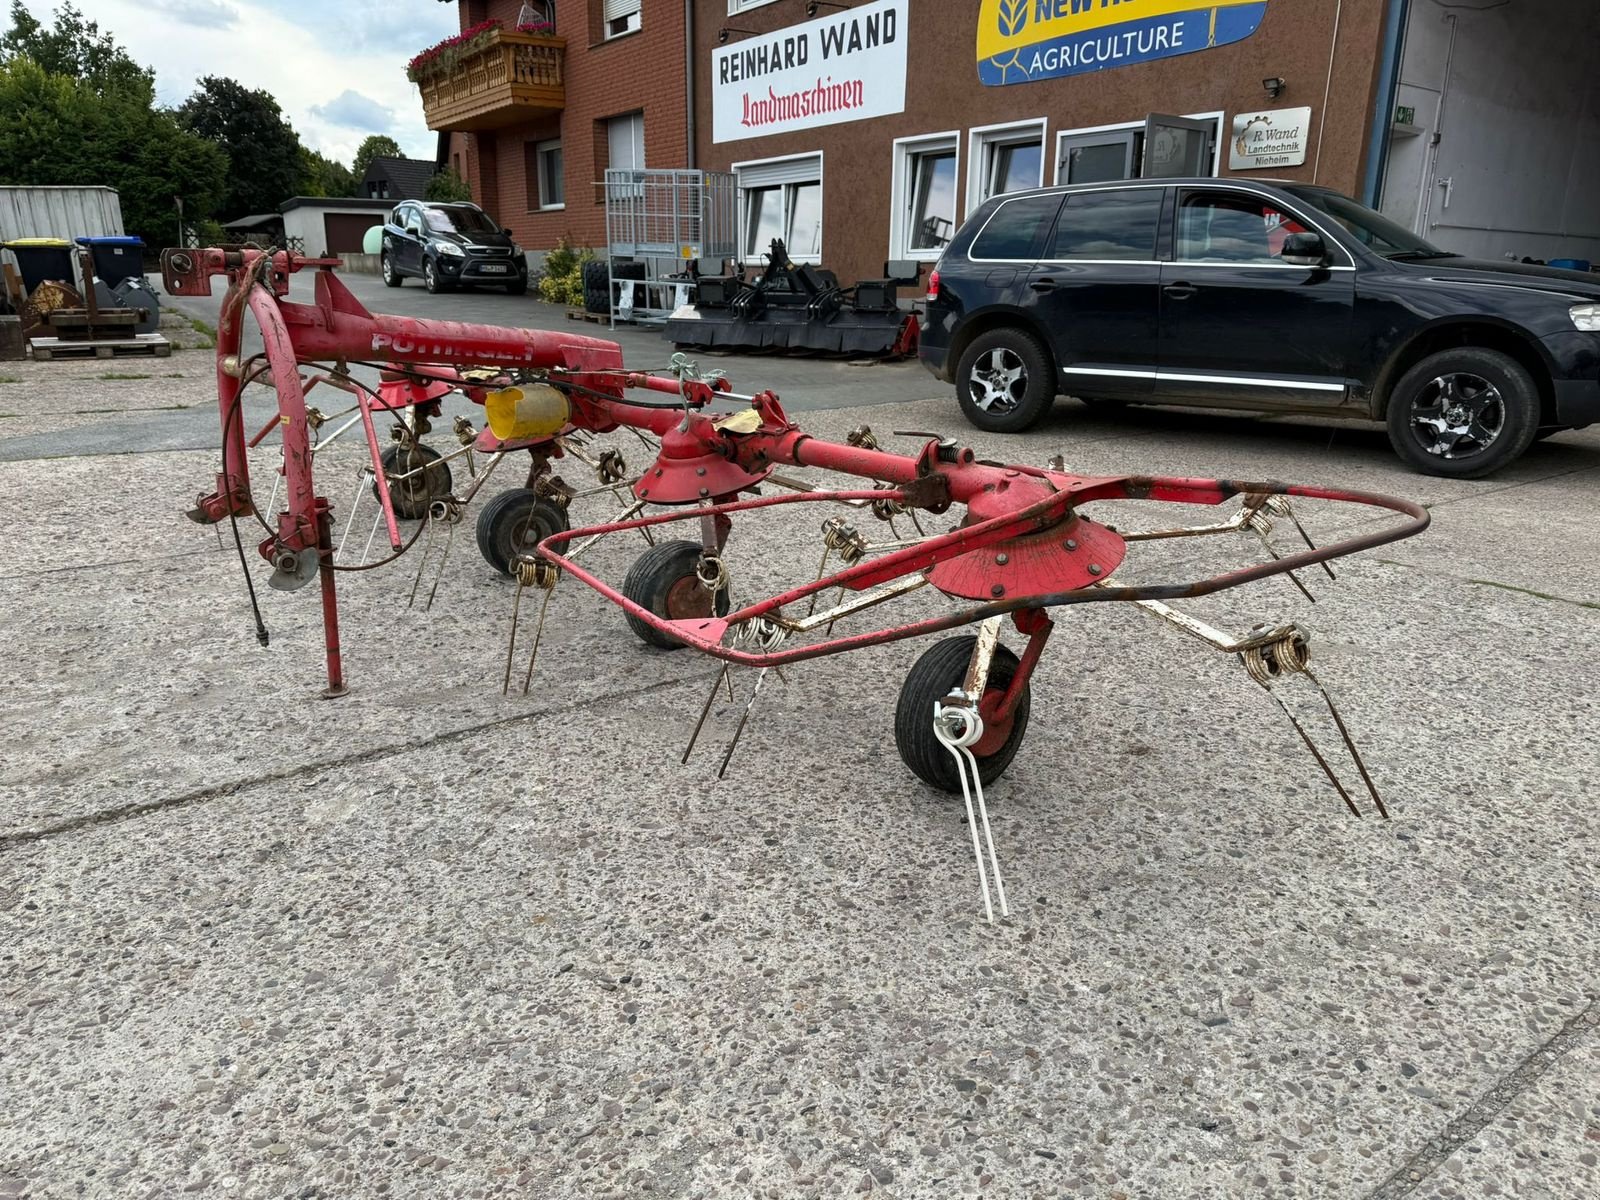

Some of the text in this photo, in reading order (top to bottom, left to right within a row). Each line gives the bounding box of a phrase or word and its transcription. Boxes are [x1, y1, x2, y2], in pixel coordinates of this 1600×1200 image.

[1034, 0, 1092, 23] NEW
[720, 8, 896, 85] REINHARD WAND
[1029, 21, 1185, 74] AGRICULTURE
[741, 76, 863, 128] Landmaschinen
[1253, 126, 1299, 142] R. Wand
[1248, 142, 1299, 154] Landtechnik
[1255, 155, 1289, 165] Nieheim
